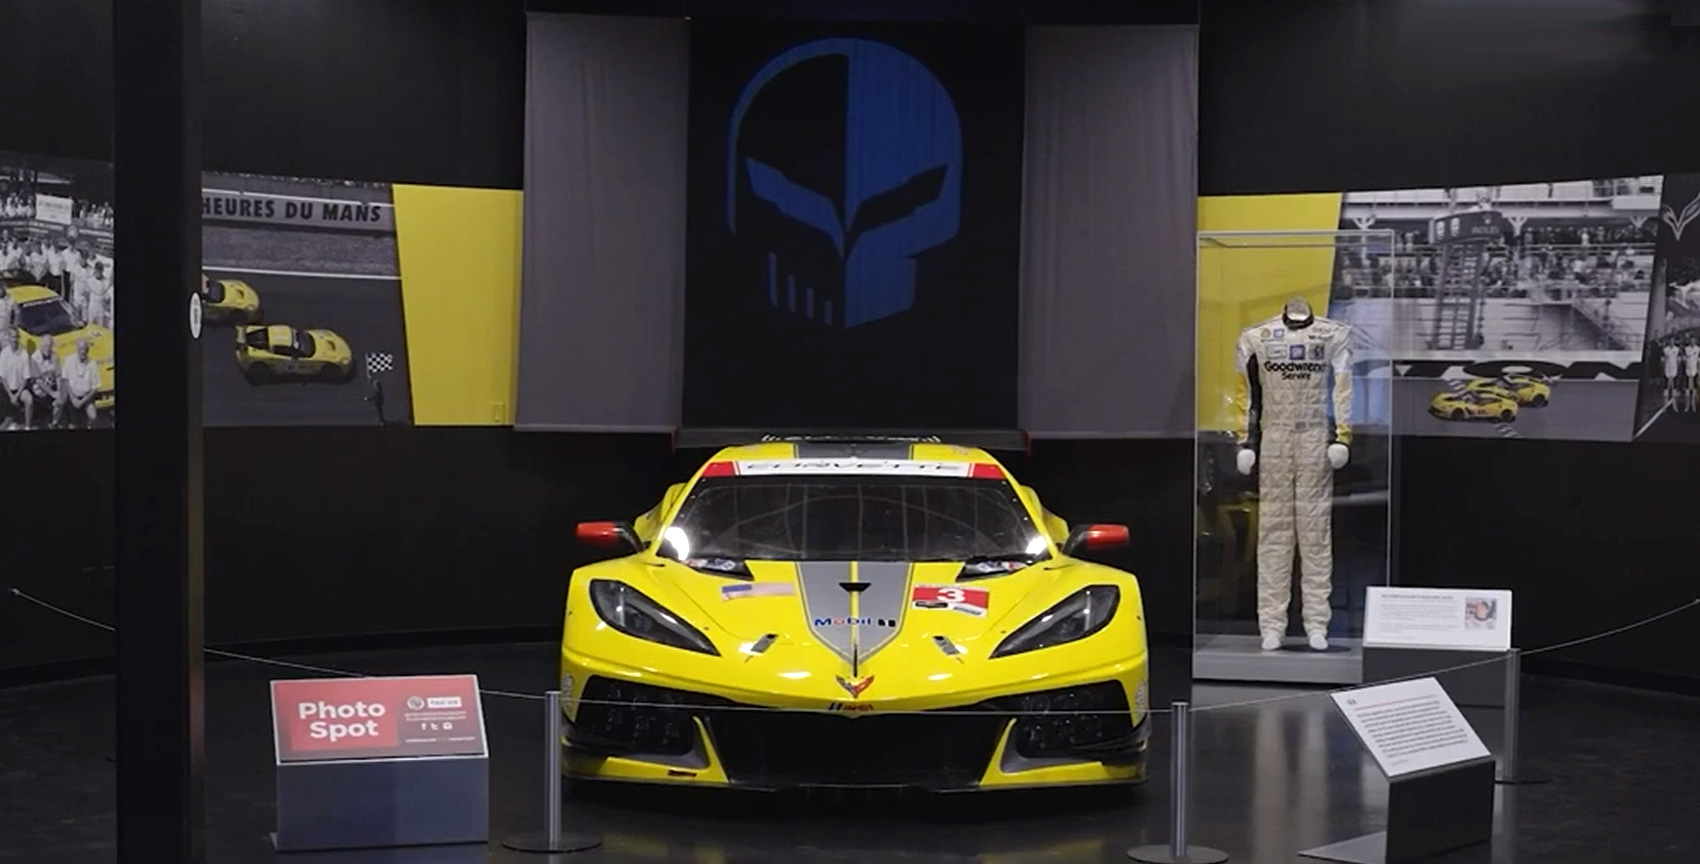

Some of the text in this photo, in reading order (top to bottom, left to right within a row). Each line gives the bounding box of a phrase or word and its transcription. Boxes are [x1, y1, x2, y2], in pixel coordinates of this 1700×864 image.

[201, 197, 381, 222] HEURES DU MANS
[937, 588, 965, 602] 3
[815, 618, 871, 626] Mobil
[299, 701, 386, 719] Photo
[310, 720, 379, 742] Spot
